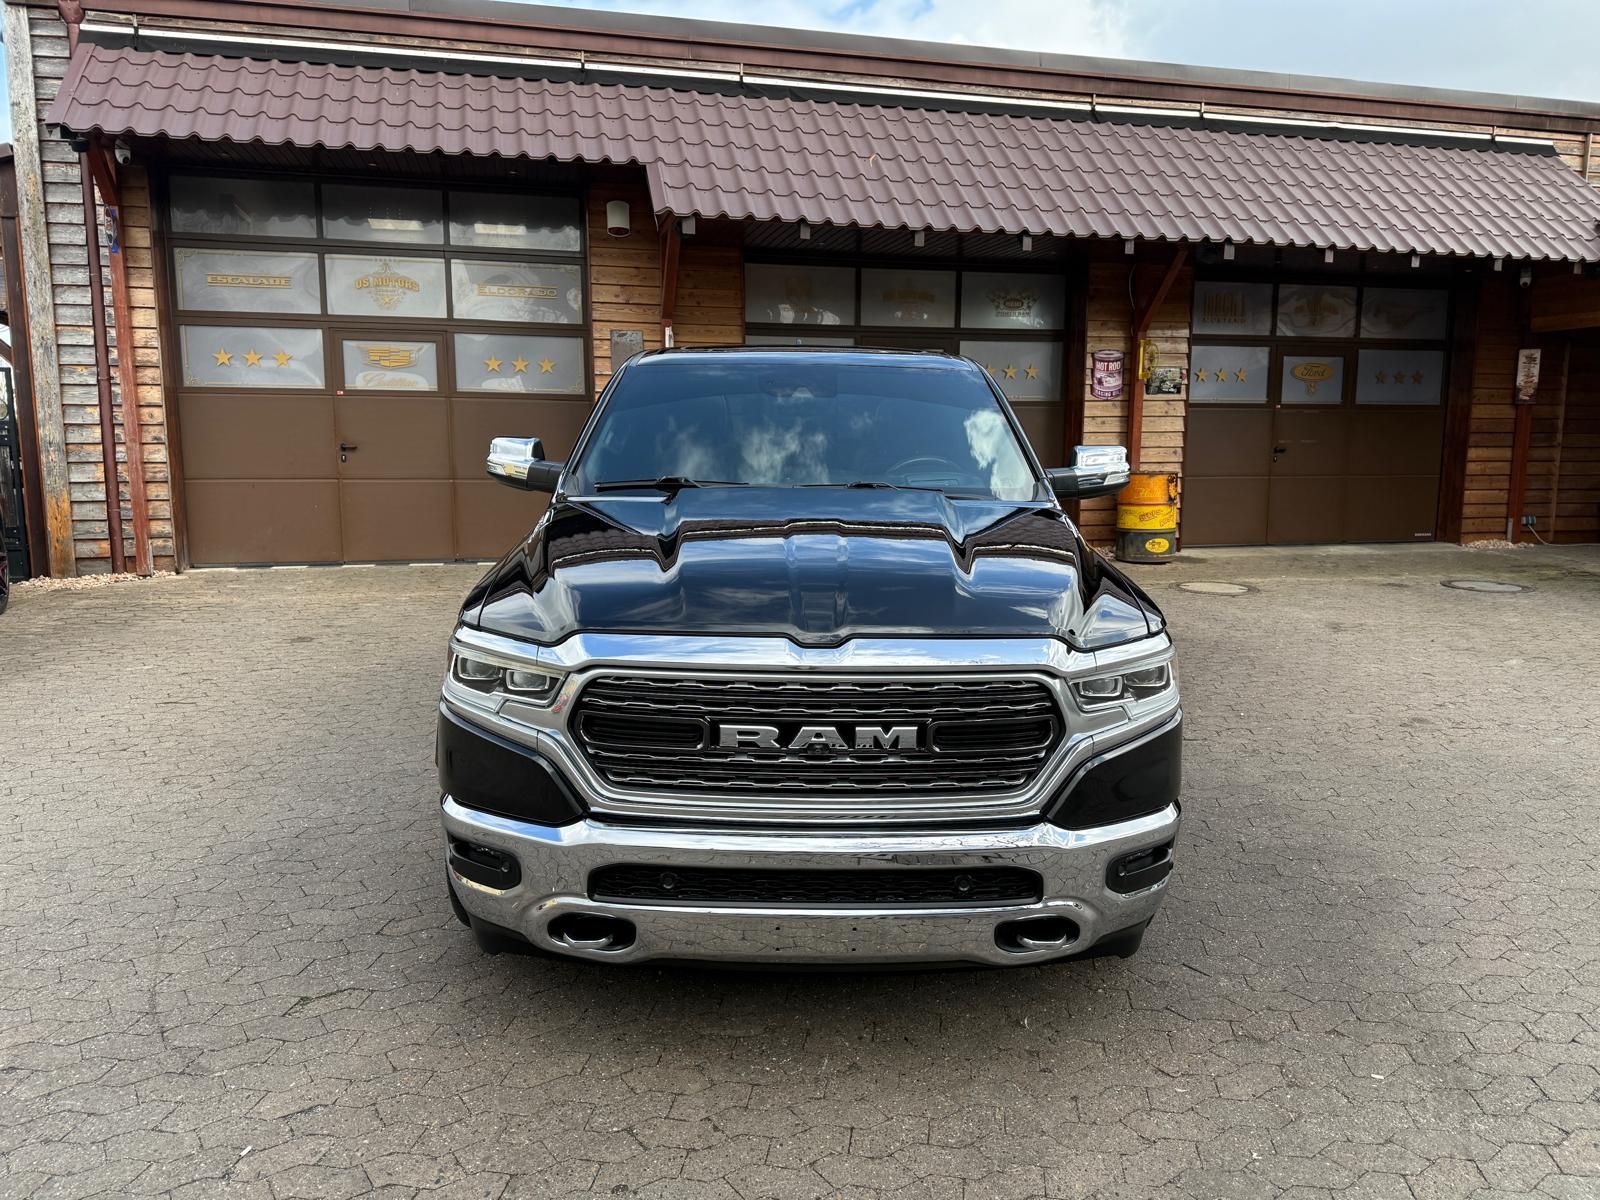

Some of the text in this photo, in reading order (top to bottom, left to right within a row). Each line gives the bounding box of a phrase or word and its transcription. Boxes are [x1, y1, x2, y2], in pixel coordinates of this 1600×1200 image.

[207, 275, 290, 287] ESCALADE
[355, 278, 369, 289] US
[373, 275, 420, 292] MOTORS
[477, 285, 558, 298] ELDORADO
[1095, 361, 1121, 371] HOT ROD
[719, 724, 918, 749] RAM
